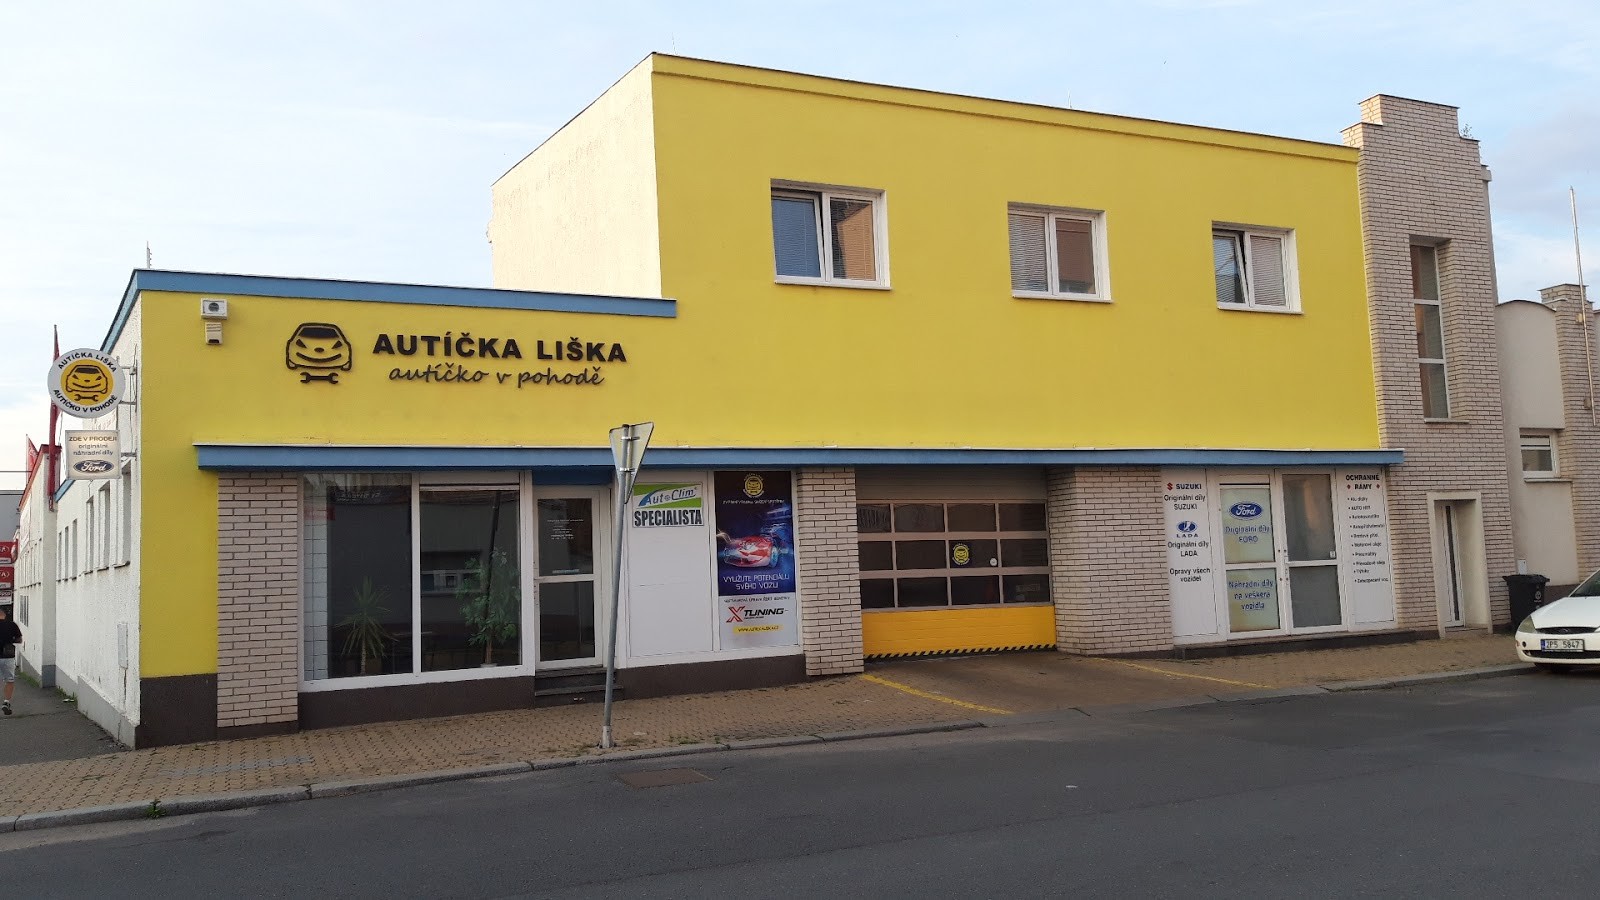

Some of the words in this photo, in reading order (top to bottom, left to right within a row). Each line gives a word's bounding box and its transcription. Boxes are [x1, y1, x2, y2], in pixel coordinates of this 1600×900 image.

[372, 331, 523, 359] AUTÍČKA
[537, 336, 628, 363] LIŠKA
[95, 354, 117, 373] LIŠKA
[388, 362, 490, 383] autíčko
[495, 370, 512, 384] v
[517, 365, 606, 388] pohodě
[90, 395, 118, 413] POHODĚ
[1345, 473, 1380, 481] OCHRANNÉ
[1174, 503, 1198, 511] SUZUKI
[634, 509, 702, 526] SPECIALISTA
[1238, 535, 1259, 543] FORD
[1169, 568, 1191, 576] Opravy
[1241, 601, 1265, 610] vozidla
[1562, 640, 1580, 649] 5847
